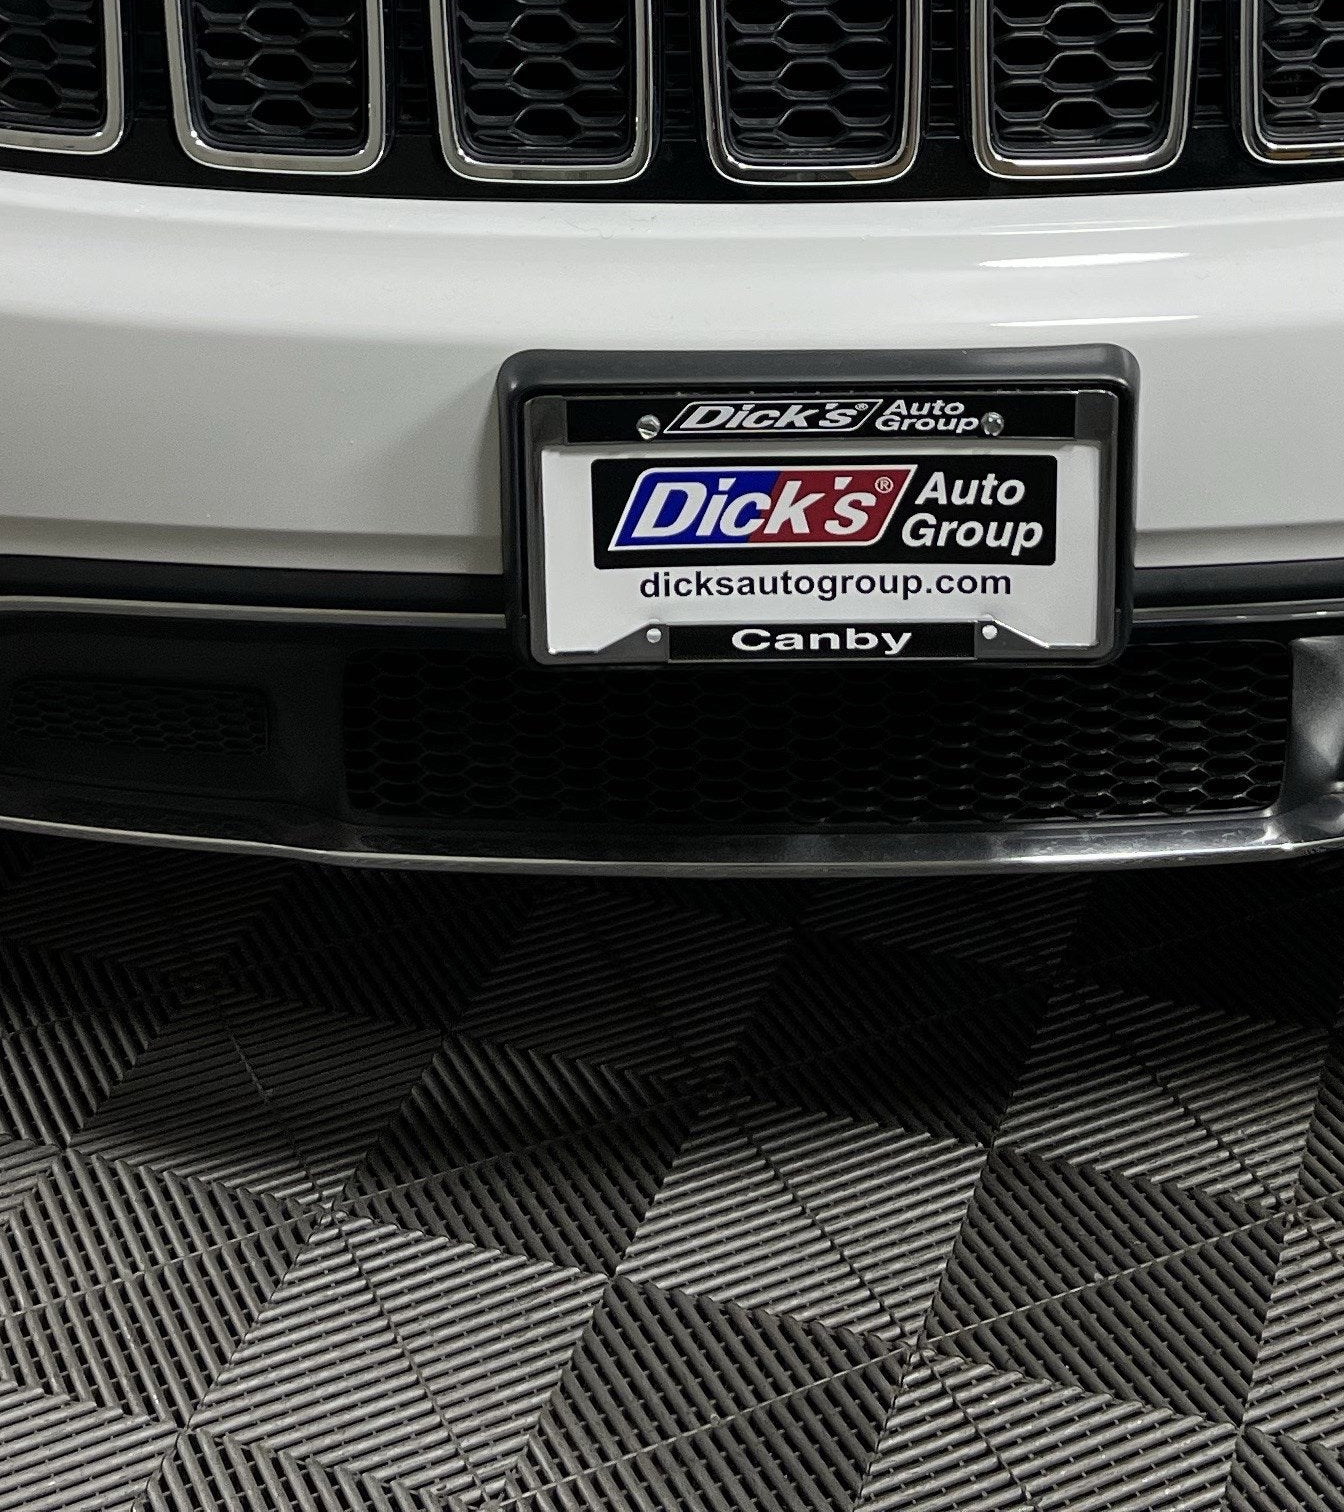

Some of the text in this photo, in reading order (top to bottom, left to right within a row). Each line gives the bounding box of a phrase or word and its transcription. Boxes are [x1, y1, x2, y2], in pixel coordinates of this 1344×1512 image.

[882, 399, 965, 416] Auto
[874, 415, 979, 434] Group
[915, 472, 1026, 507] Auto
[901, 513, 1044, 555] Group
[639, 570, 1012, 601] dicksautogroup.com
[731, 628, 913, 656] Canby
